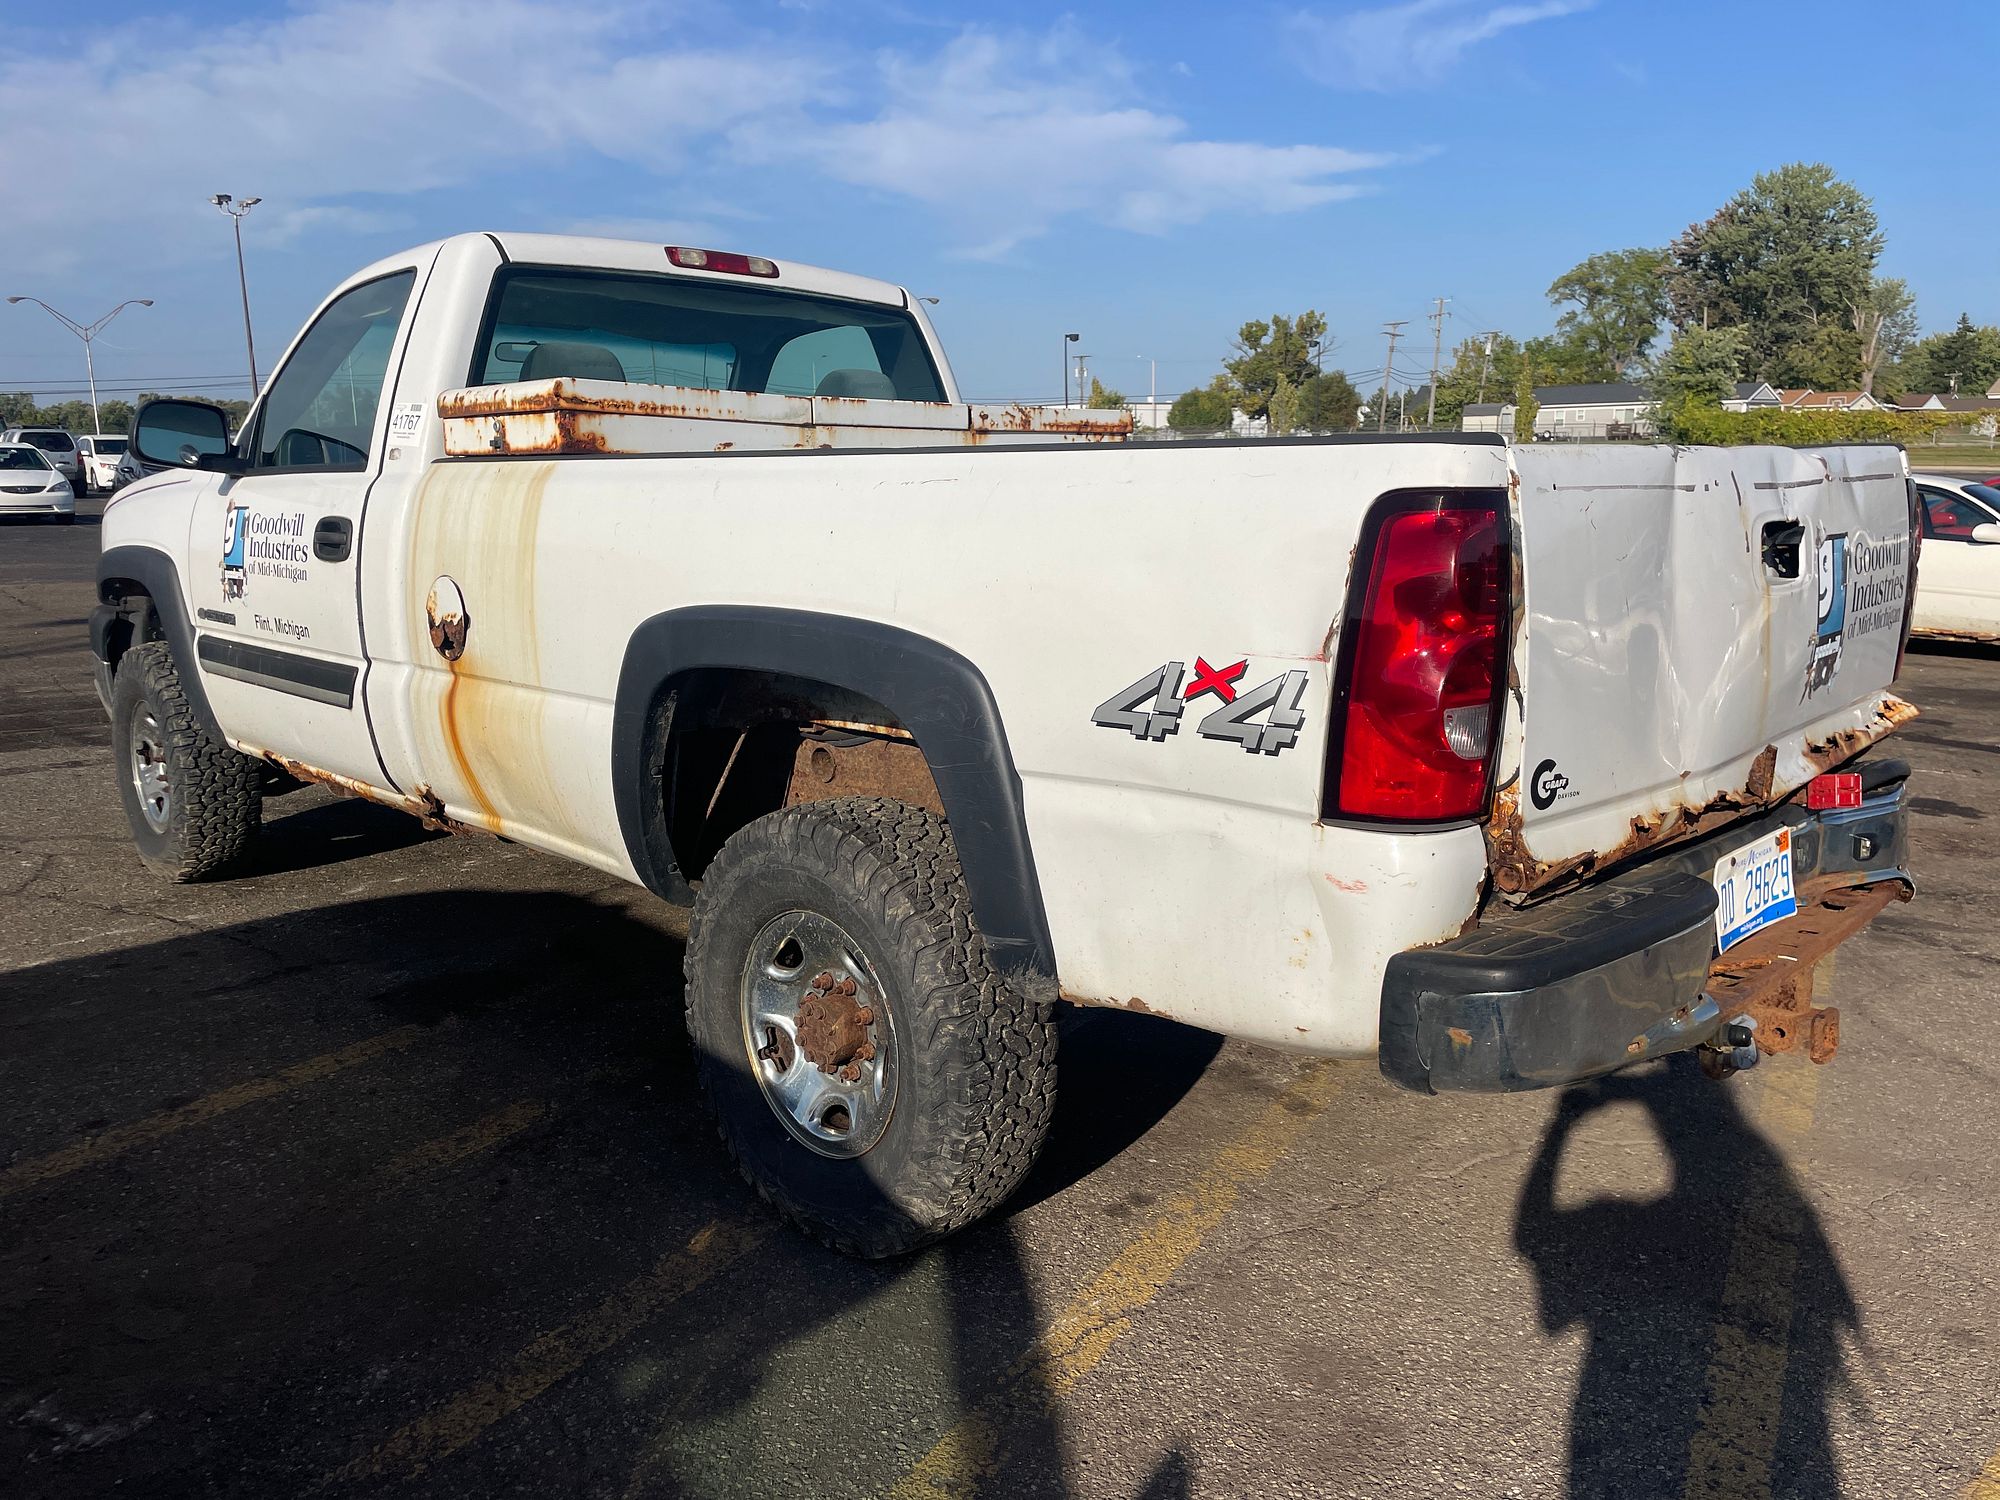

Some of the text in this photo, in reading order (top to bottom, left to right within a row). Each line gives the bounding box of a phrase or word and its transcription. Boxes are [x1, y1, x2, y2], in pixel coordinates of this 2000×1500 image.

[392, 414, 421, 430] 41767
[251, 512, 305, 537] Goodwill
[248, 536, 309, 563] Industries
[1854, 533, 1902, 575] Goodwill
[248, 560, 308, 584] of Mid-Michigan
[1851, 569, 1905, 613] Industries
[254, 614, 274, 635] Flint,
[274, 617, 311, 641] Michigan
[1847, 605, 1901, 640] of Mid-Michigan
[1745, 853, 1791, 914] 29629
